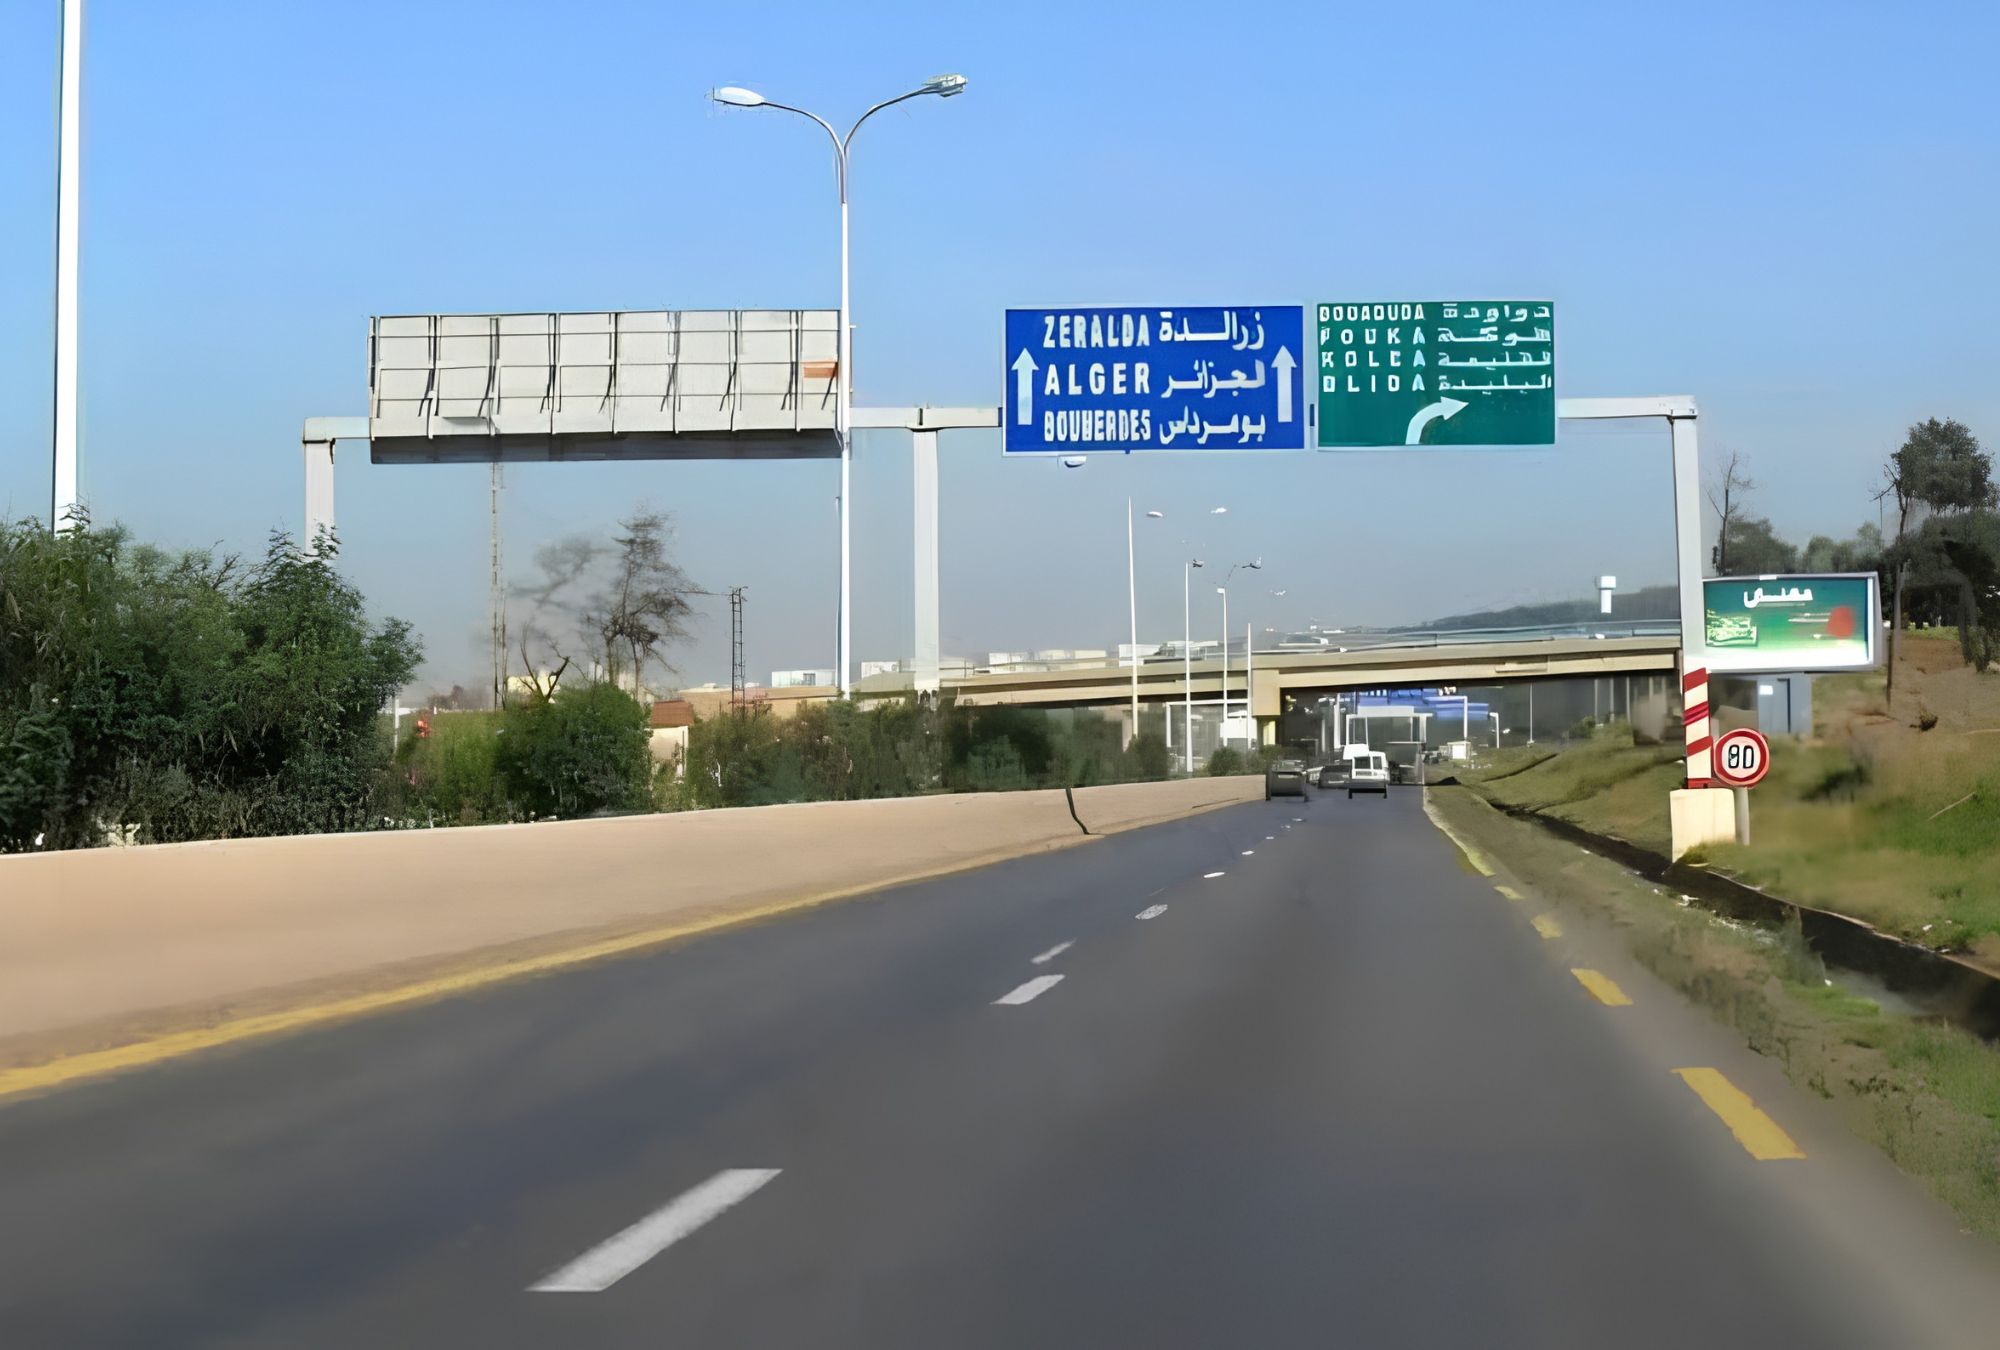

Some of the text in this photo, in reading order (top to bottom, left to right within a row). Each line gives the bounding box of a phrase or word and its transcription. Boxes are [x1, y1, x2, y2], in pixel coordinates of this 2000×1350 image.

[1043, 314, 1150, 348] ZERALDA
[1045, 363, 1150, 396] ALGER
[1728, 745, 1754, 769] 80
